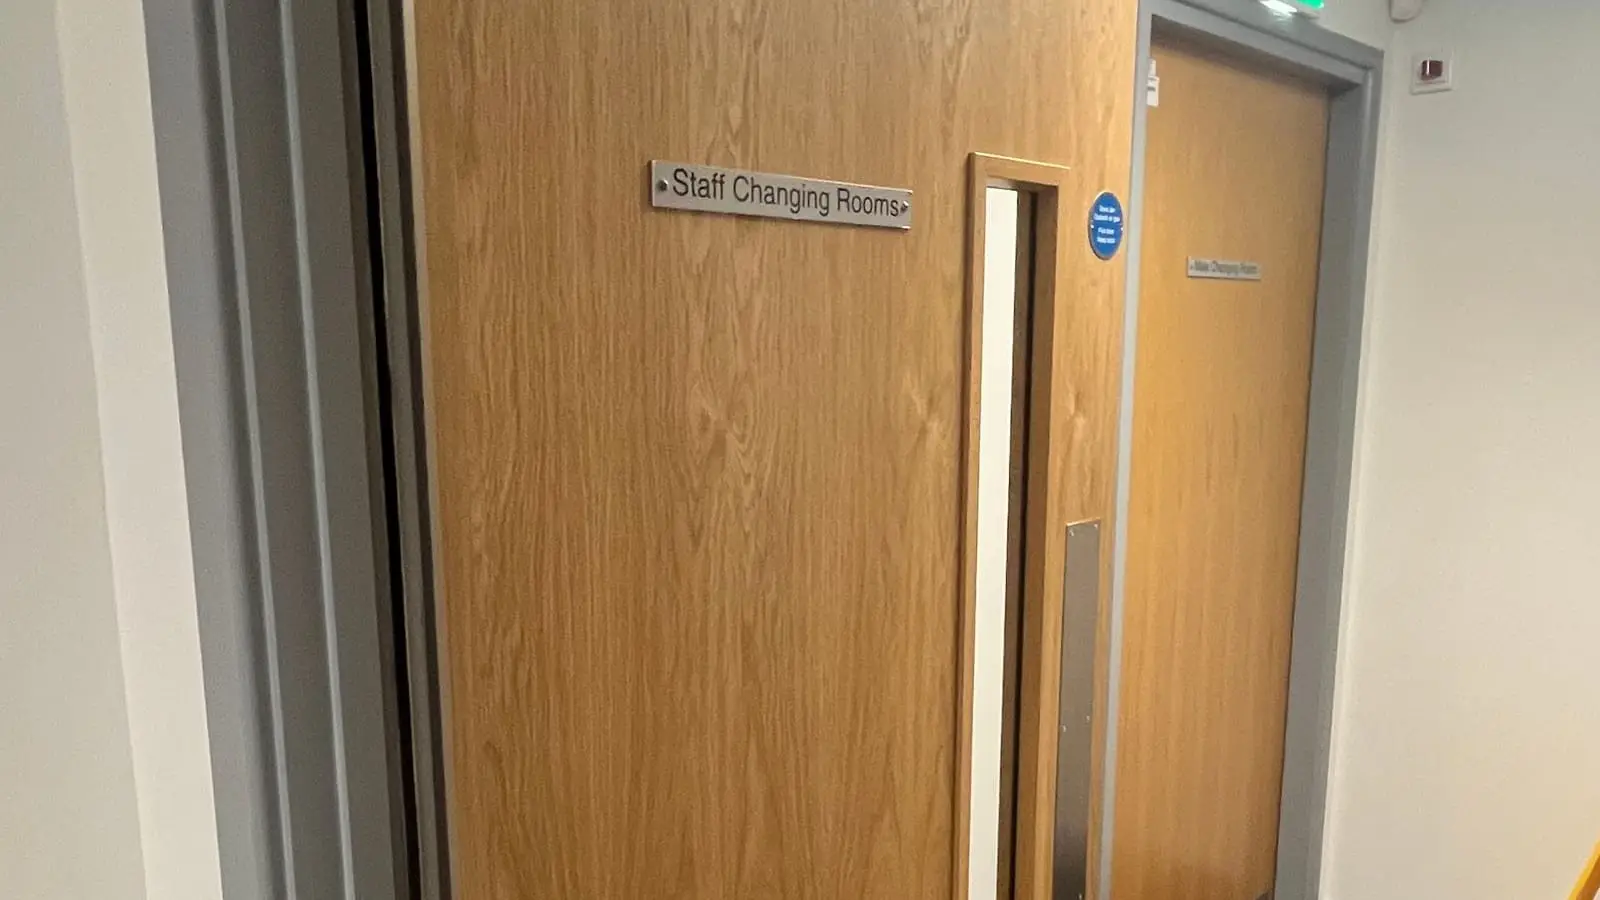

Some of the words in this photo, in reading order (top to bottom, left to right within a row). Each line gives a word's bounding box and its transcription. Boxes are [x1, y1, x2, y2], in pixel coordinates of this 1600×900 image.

[672, 168, 726, 200] Staff
[733, 175, 830, 217] Changing
[837, 187, 899, 217] Rooms
